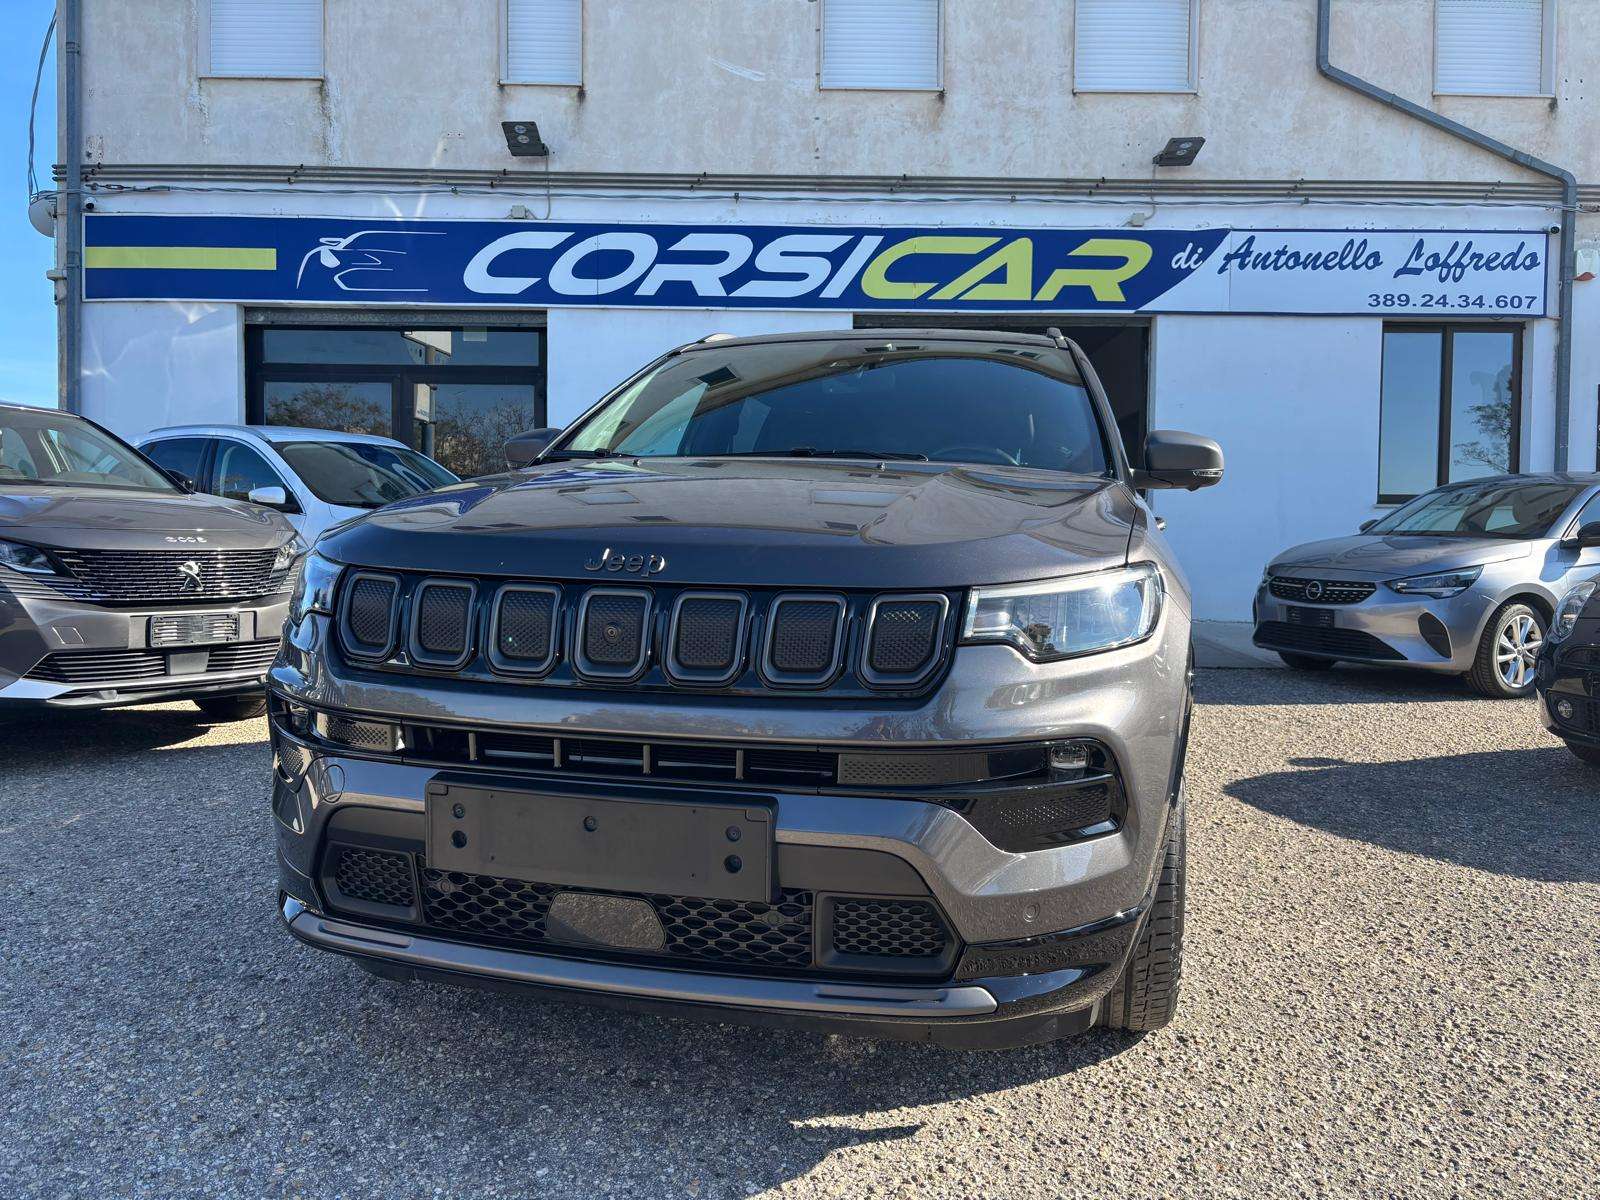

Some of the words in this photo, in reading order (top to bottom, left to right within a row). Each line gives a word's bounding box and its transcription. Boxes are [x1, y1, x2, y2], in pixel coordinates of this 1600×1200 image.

[463, 231, 1152, 302] CORSICAR
[1171, 242, 1204, 270] di
[1217, 235, 1383, 275] Antonello
[1393, 238, 1541, 283] Loffredo
[1367, 293, 1537, 309] 389.24.34.607
[584, 547, 666, 577] Jeep
